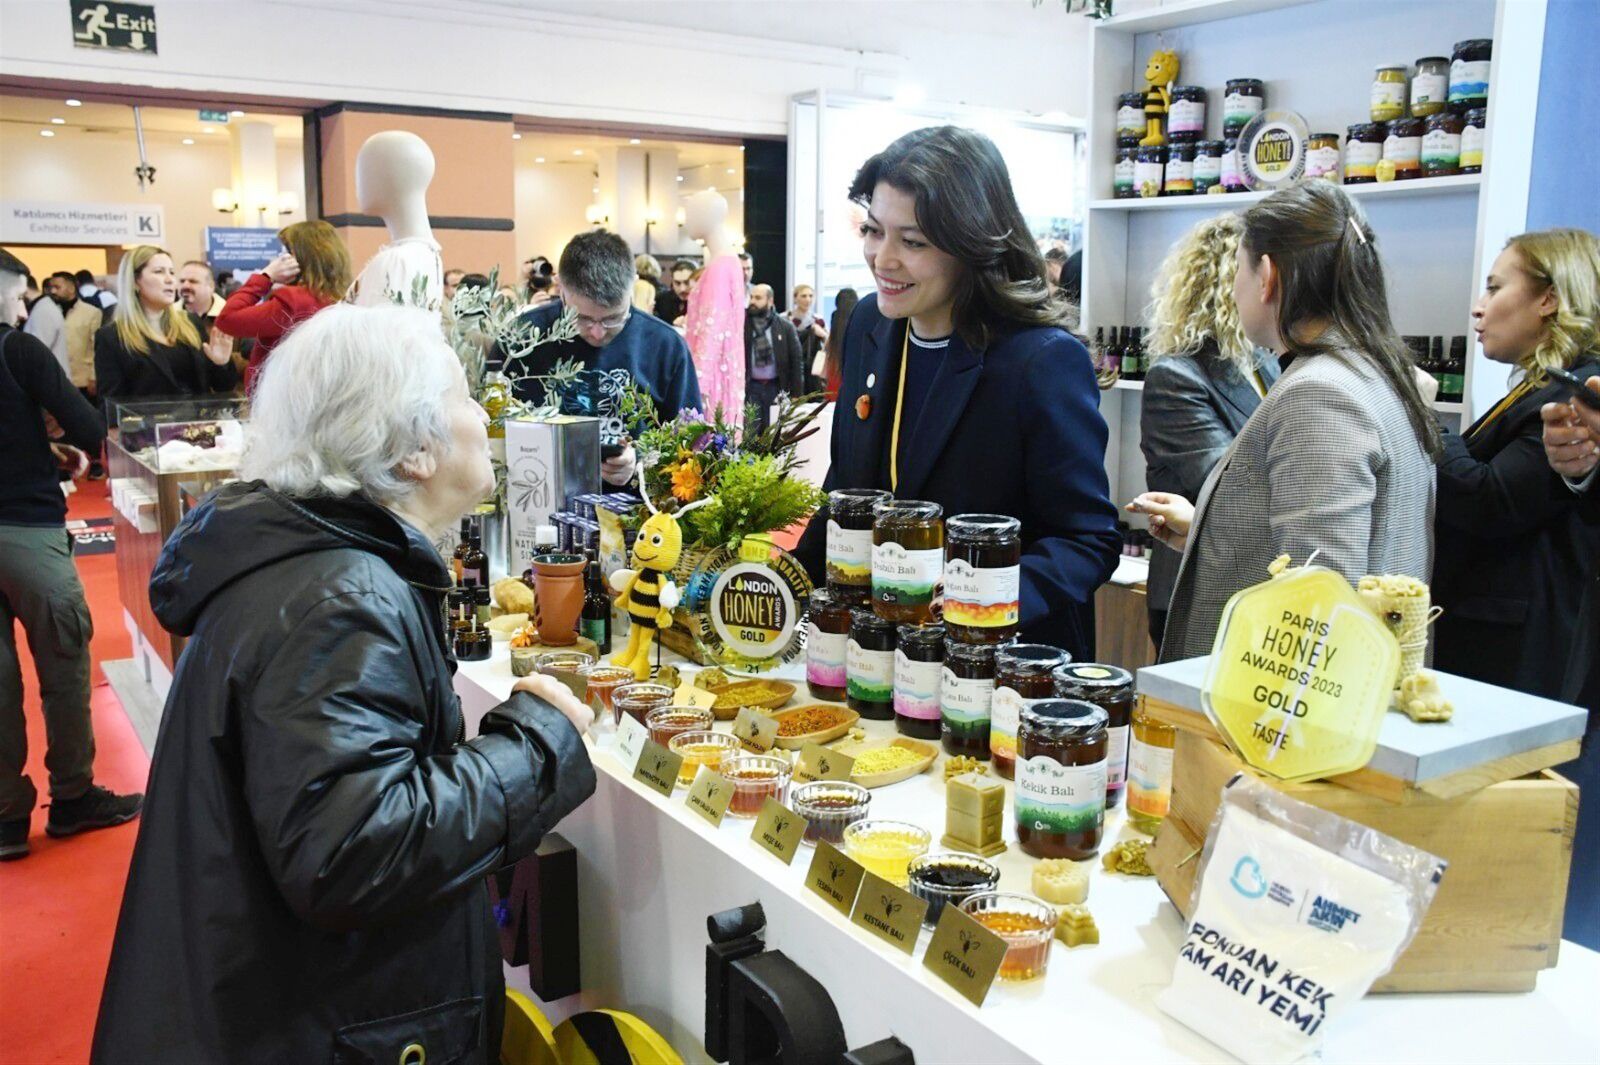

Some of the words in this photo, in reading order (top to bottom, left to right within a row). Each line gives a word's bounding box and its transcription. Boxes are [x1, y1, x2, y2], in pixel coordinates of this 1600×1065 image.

[117, 13, 155, 32] Exit
[1257, 141, 1287, 162] HONEY
[1265, 164, 1281, 172] GOLD
[14, 208, 67, 220] Katılımcı
[68, 210, 128, 222] Hizmetleri
[139, 216, 153, 232] K
[29, 222, 80, 234] Exhibitor
[83, 224, 129, 236] Services
[897, 565, 916, 575] Balı
[728, 577, 778, 595] LONDON
[724, 591, 775, 627] HONEY
[1282, 610, 1330, 637] PARIS
[740, 629, 766, 643] GOLD
[1261, 625, 1338, 672] HONEY
[1240, 651, 1311, 686] AWARDS
[1311, 676, 1343, 698] 2023
[1253, 685, 1309, 718] GOLD
[1252, 722, 1289, 750] TASTE
[1021, 778, 1048, 795] Kekik
[1050, 785, 1075, 797] Balı
[1309, 907, 1347, 930] AKIN
[1312, 895, 1362, 924] AHMET
[863, 912, 890, 934] KESTANE
[889, 927, 905, 942] BALI
[961, 961, 976, 980] BALI
[1210, 962, 1255, 996] ARI
[1256, 984, 1327, 1037] YEMİ
[1277, 969, 1336, 1013] KEK
